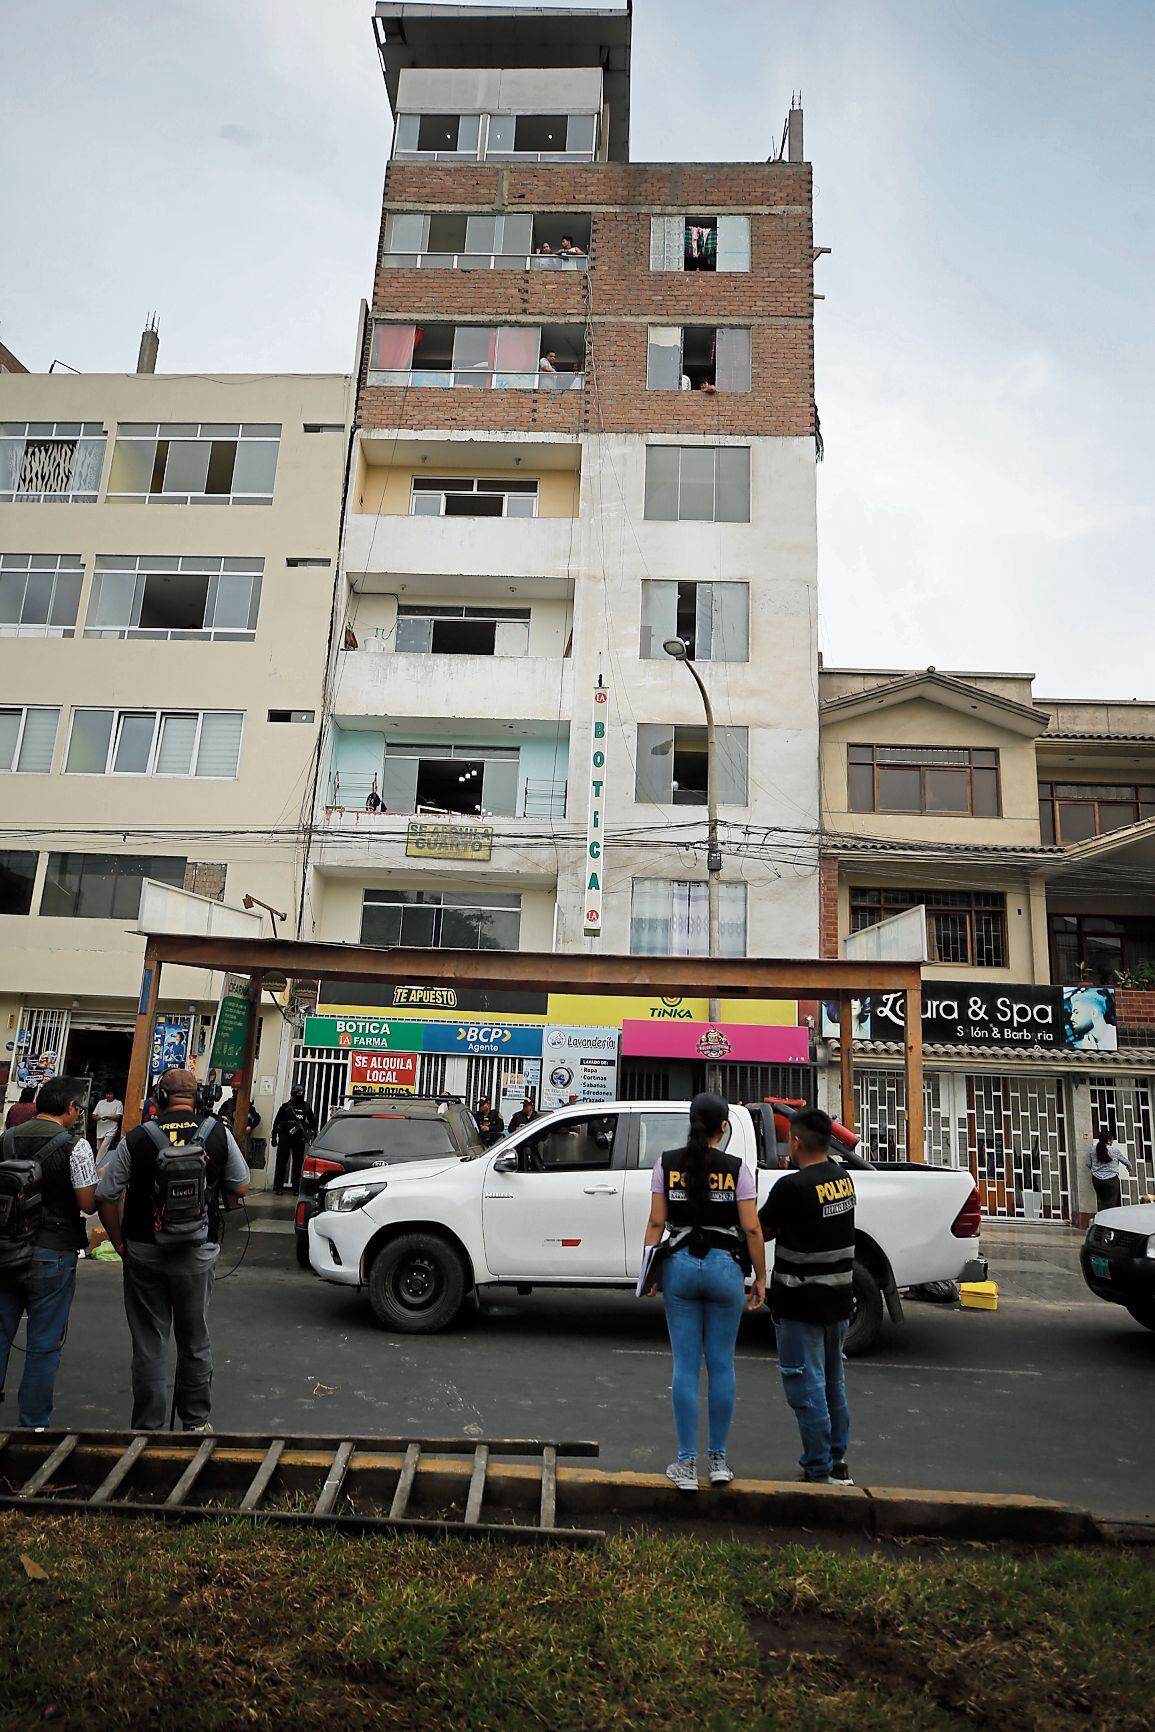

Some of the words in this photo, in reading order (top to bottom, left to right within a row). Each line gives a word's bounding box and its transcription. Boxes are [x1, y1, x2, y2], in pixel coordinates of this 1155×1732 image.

[588, 722, 605, 891] BOTICA
[396, 988, 408, 1003] TE
[409, 989, 455, 1006] APUESTO
[968, 996, 989, 1021] &
[997, 997, 1053, 1027] Spa
[336, 1020, 391, 1035] BOTICA
[466, 1027, 503, 1043] BCP
[956, 1026, 989, 1039] Slón
[992, 1028, 1002, 1039] &
[1004, 1028, 1054, 1041] Barbria
[353, 1036, 388, 1048] FARMA
[468, 1043, 499, 1052] Agente
[355, 1055, 368, 1068] SE
[370, 1056, 413, 1070] ALQUILA
[366, 1069, 398, 1083] LOCAL
[160, 1121, 198, 1131] RENSA
[669, 1170, 735, 1190] PCIA
[172, 1188, 193, 1197] LiveU
[815, 1177, 854, 1204] POLICIA
